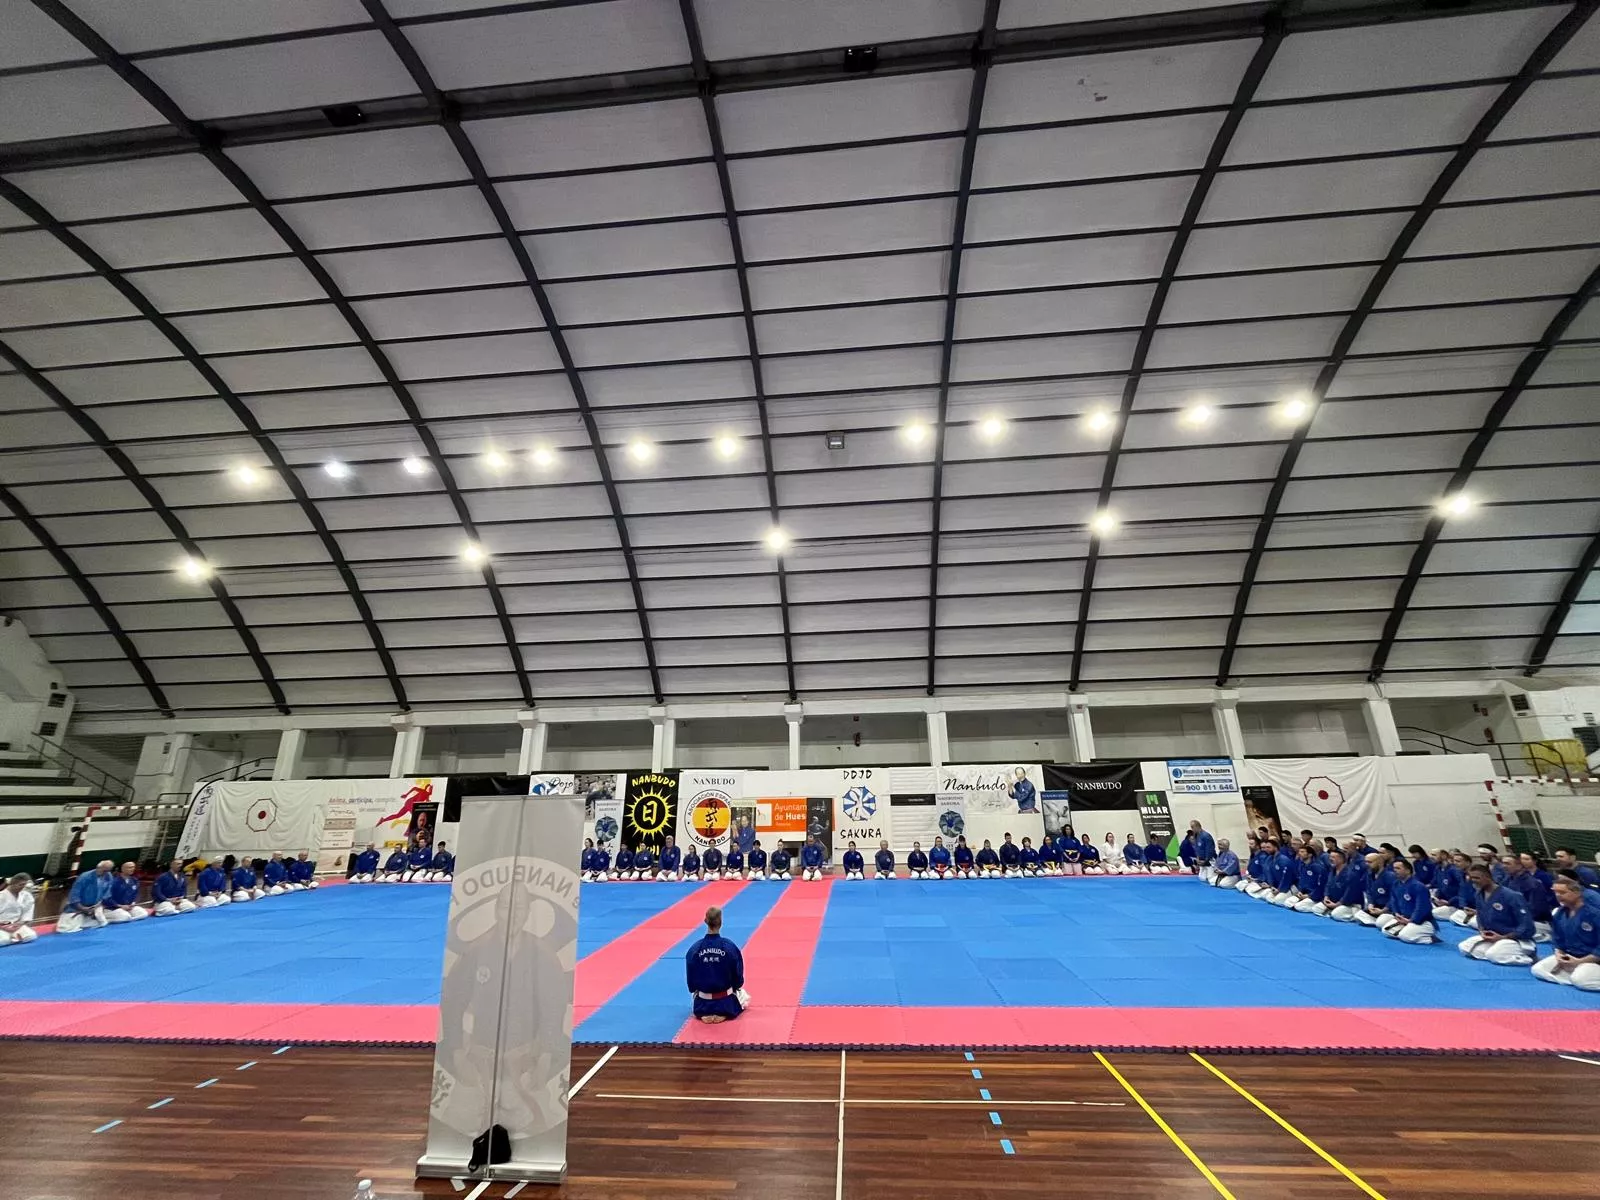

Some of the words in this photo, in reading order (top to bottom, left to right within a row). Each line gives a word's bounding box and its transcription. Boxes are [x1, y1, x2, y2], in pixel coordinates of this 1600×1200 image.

[843, 769, 872, 780] DOJO
[550, 777, 574, 793] Dojo
[632, 774, 676, 788] NANBUDO
[943, 776, 1006, 791] Nanbudo
[1075, 782, 1122, 790] NANBUDO
[774, 803, 807, 812] Ayuntam
[1141, 806, 1169, 814] MILAR
[786, 812, 807, 820] Hues
[840, 828, 882, 839] SAKURA
[694, 835, 726, 845] NANDO
